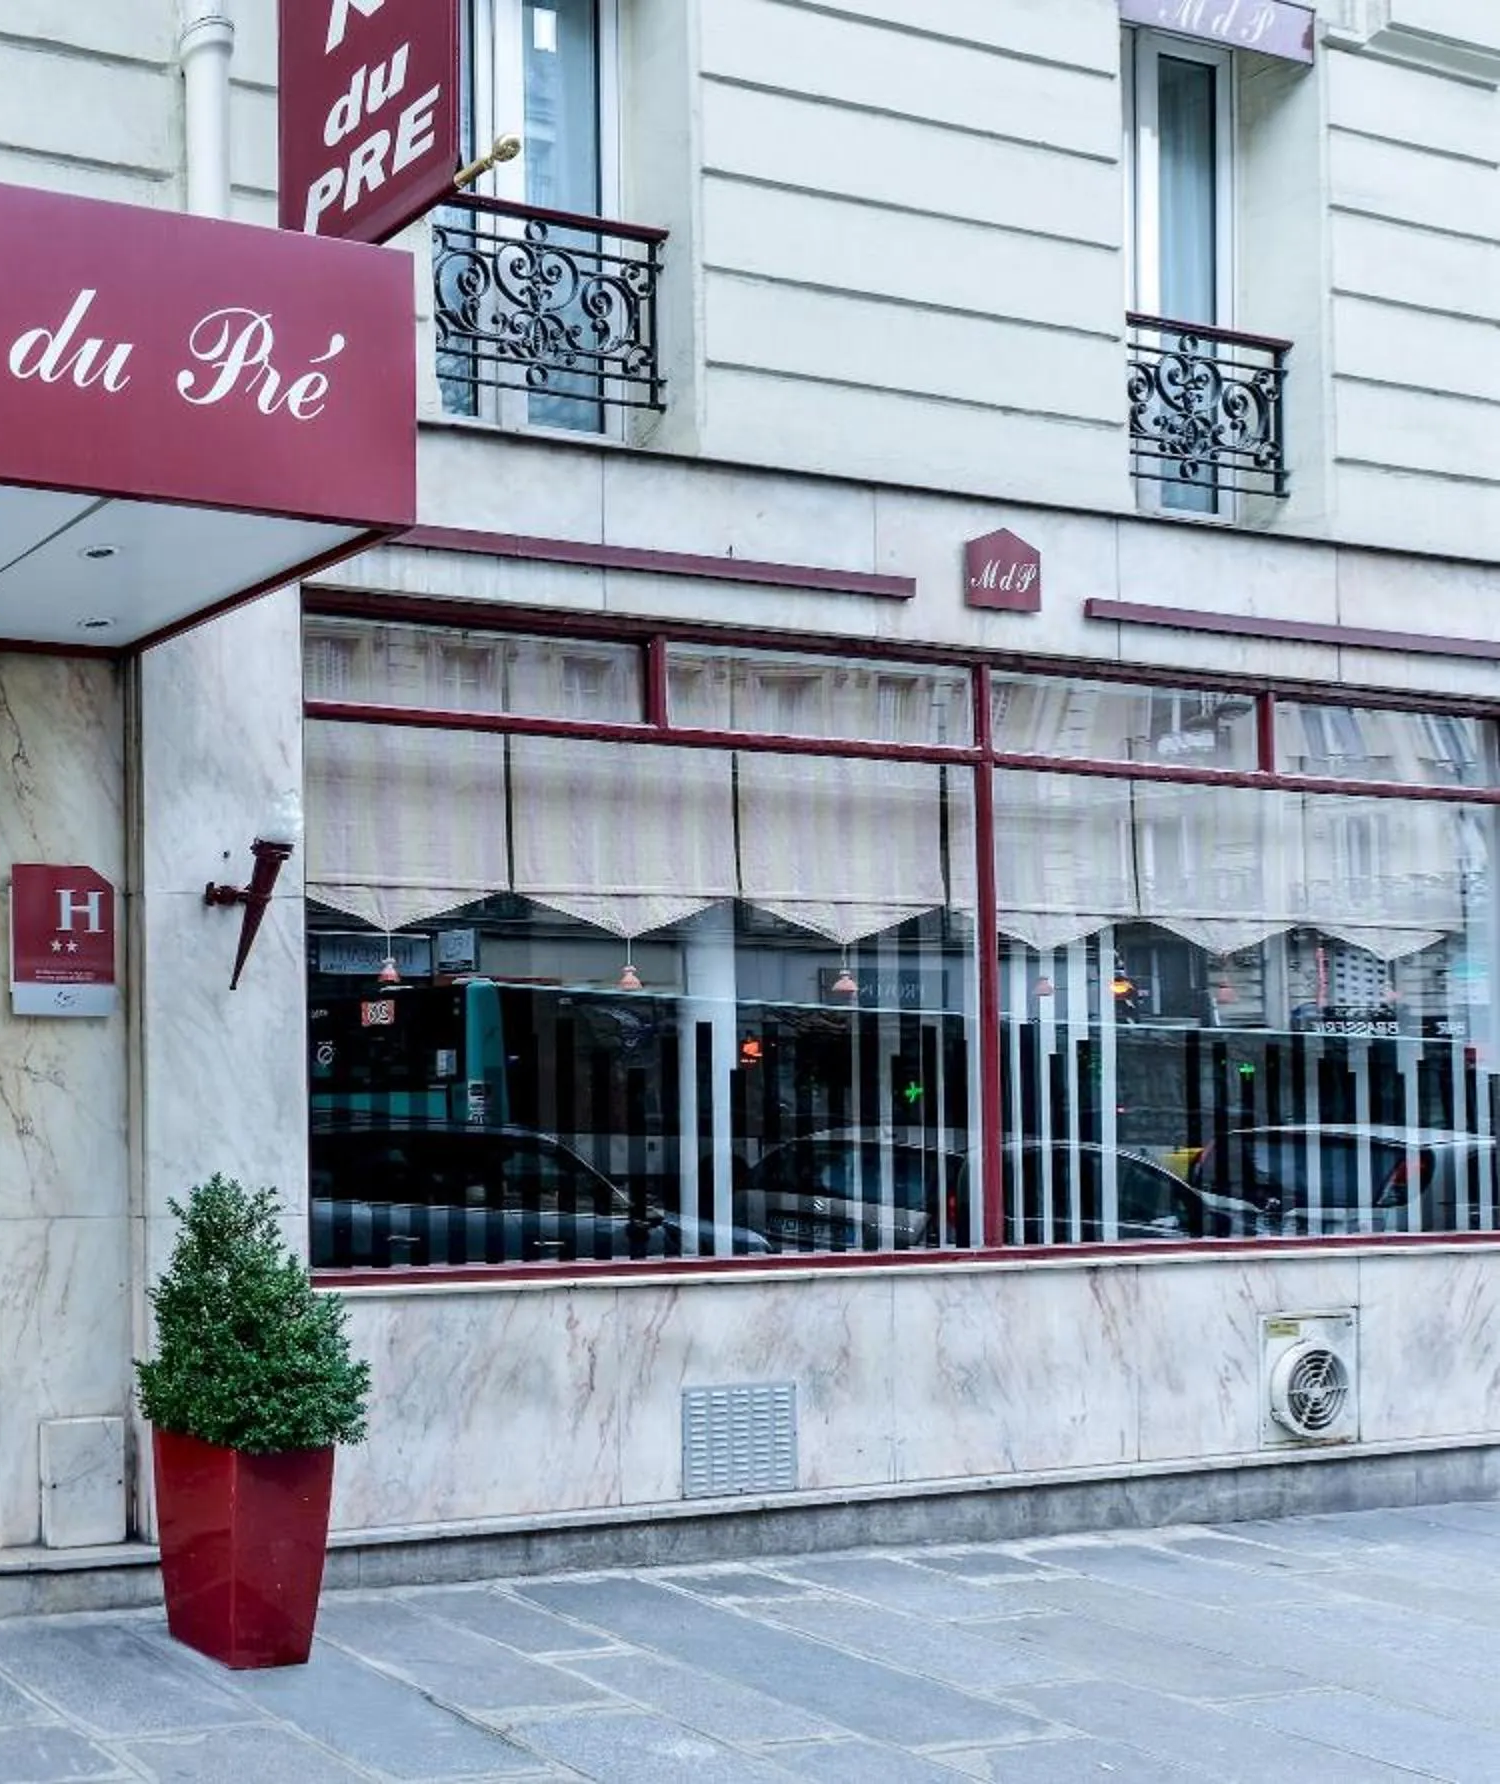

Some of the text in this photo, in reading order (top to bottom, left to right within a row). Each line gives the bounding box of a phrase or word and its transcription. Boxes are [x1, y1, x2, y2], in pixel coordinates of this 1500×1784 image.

[323, 42, 409, 147] du
[303, 83, 441, 234] PRE
[9, 288, 134, 393] du
[177, 307, 345, 420] Pré
[54, 888, 106, 934] H
